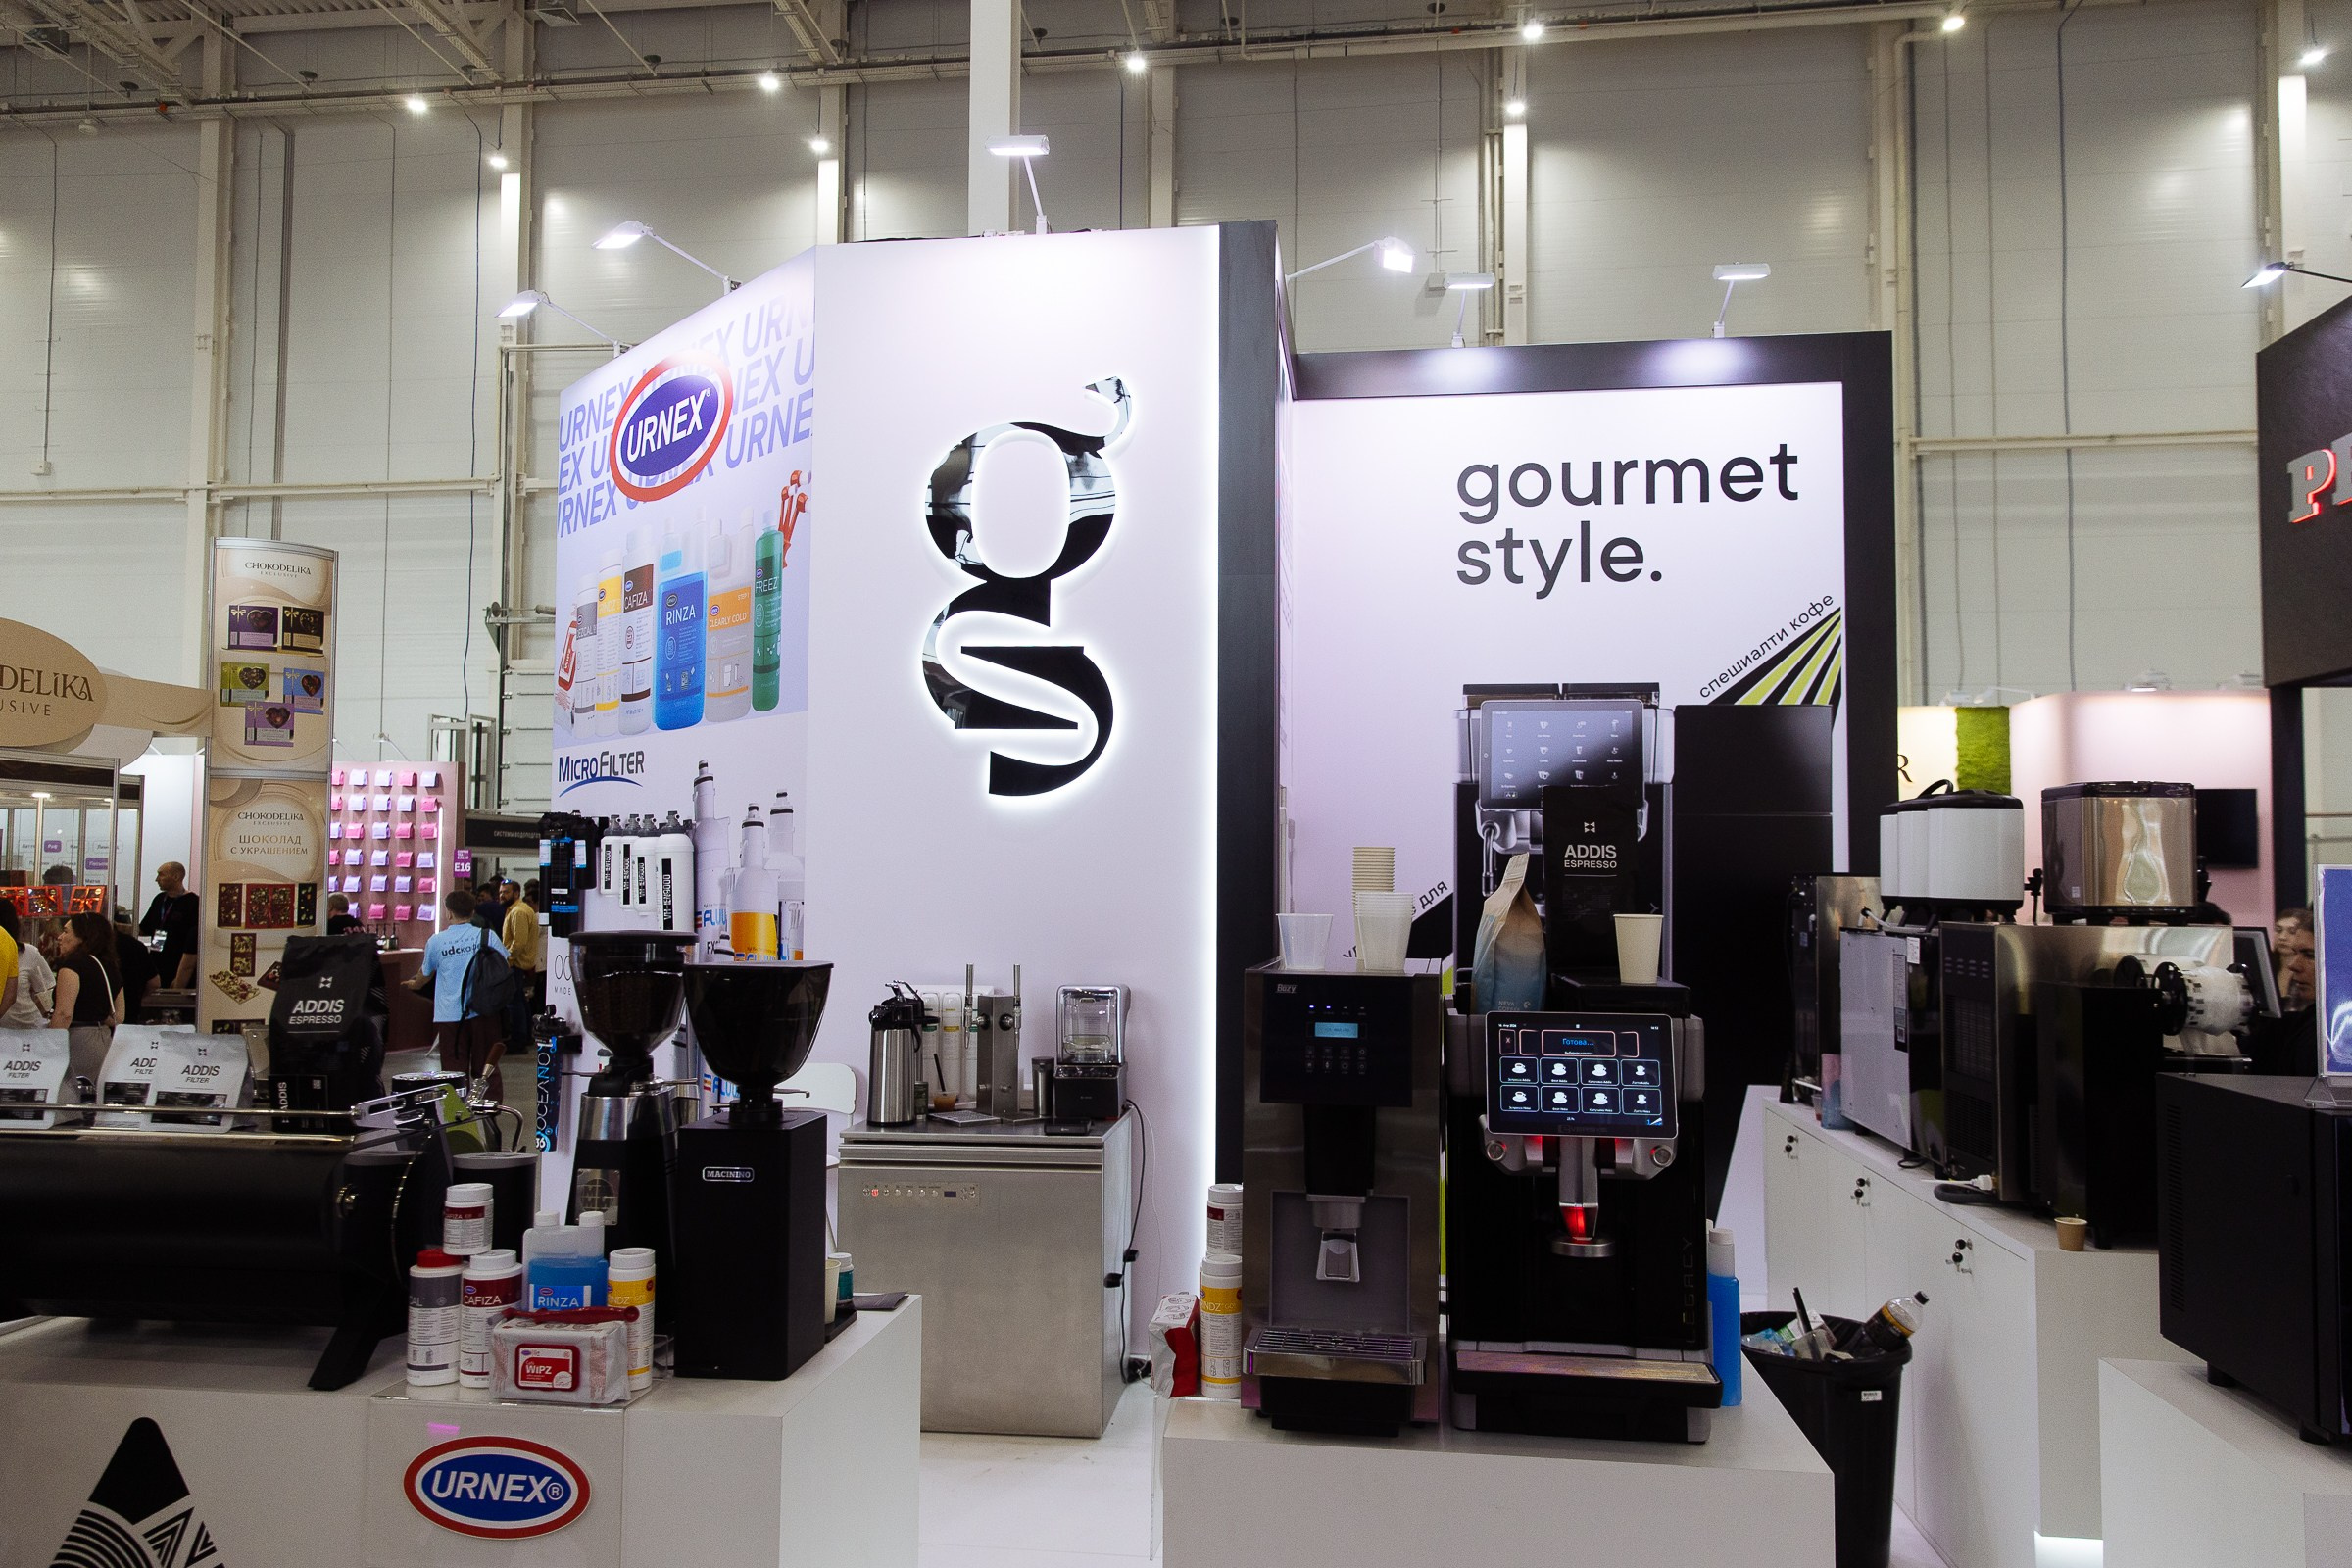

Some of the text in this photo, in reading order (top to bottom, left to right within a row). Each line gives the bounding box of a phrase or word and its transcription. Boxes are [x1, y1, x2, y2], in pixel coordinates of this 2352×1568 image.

[1457, 443, 1799, 525] gourmet
[1456, 519, 1663, 600] style.
[755, 576, 778, 593] FREEZ
[624, 591, 648, 611] CAFIZA
[665, 604, 696, 625] RINZA
[709, 612, 747, 628] CLEARLY COLD
[1699, 593, 1834, 699] спешиалти кофе
[238, 833, 302, 846] ШОКОЛАД
[239, 845, 309, 856] УКРАШЕНИЕМ
[1564, 844, 1617, 859] ADDIS
[454, 862, 471, 872] E16
[1564, 860, 1617, 869] ESPRESSO
[292, 999, 345, 1014] ADDIS
[289, 1015, 343, 1025] ESPRESSO
[3, 1060, 42, 1072] ADDIS
[181, 1064, 220, 1077] ADDIS
[278, 1081, 287, 1111] ADDIS
[706, 1170, 752, 1179] MACININO
[463, 1295, 502, 1306] CAFIZA
[537, 1295, 580, 1308] RINZA
